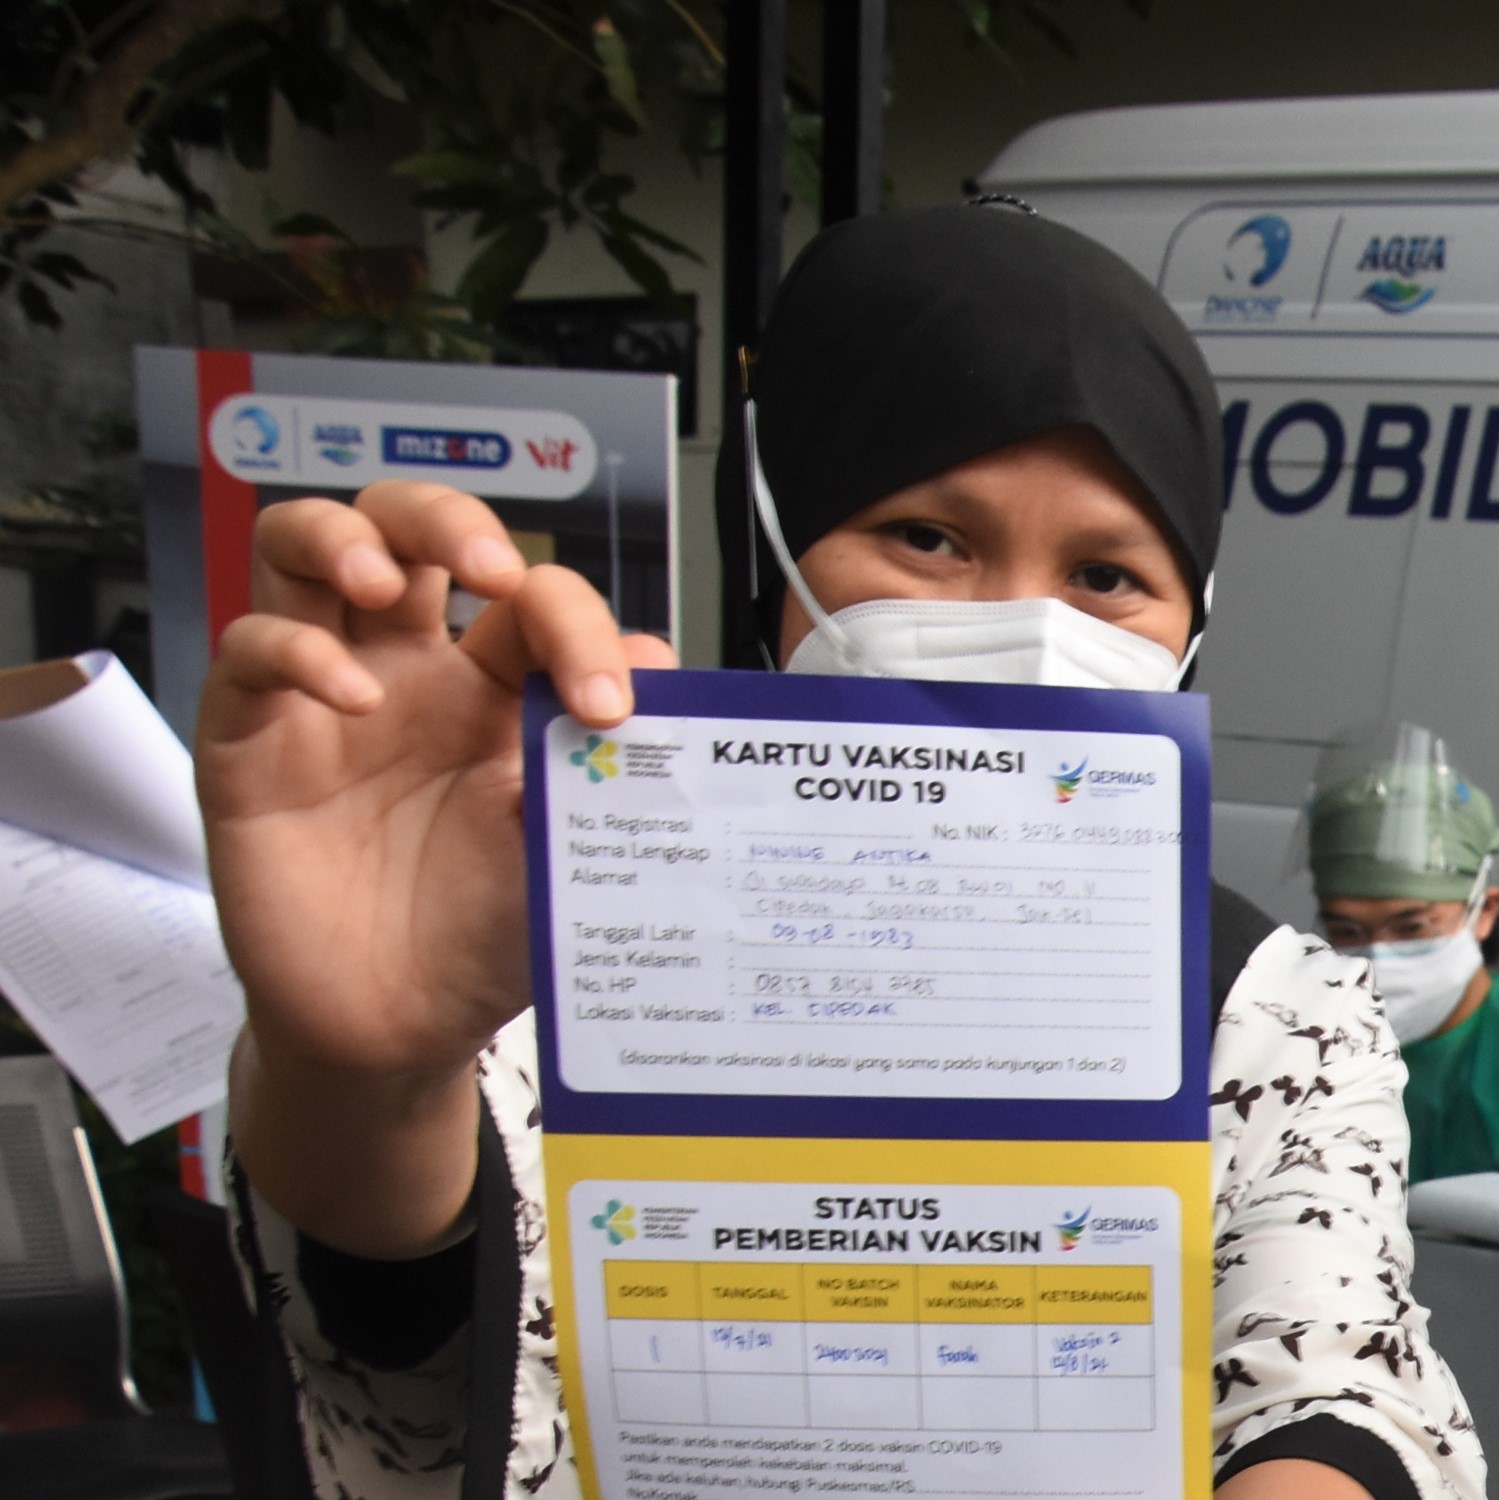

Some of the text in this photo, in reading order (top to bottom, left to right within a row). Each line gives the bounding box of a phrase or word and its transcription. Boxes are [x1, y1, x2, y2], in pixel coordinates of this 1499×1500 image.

[396, 433, 501, 463] mizone
[712, 739, 831, 769] KARTU
[842, 743, 1026, 774] VAKSINASI
[794, 777, 947, 804] COVID 19
[604, 814, 693, 835] Registrasi
[569, 841, 711, 864] Nama Lengkap
[569, 868, 638, 886] Alamat
[573, 922, 696, 944] Tanggal Lahir
[574, 951, 702, 968] Jenis Kelamin
[609, 976, 637, 993] HP
[575, 1003, 726, 1023] Lokasi Vaksinasi
[716, 1051, 786, 1068] vaksinasi
[788, 1050, 803, 1068] di
[807, 1051, 850, 1069] lokasi
[854, 1056, 893, 1073] yang
[896, 1058, 939, 1070] sama
[942, 1056, 982, 1073] pada
[986, 1056, 1062, 1075] kunjungan
[1078, 1056, 1106, 1072] dan
[814, 1196, 941, 1221] STATUS
[713, 1227, 1042, 1253] PEMBERIAN VAKSIN
[618, 1285, 790, 1301] DOSIS TANGGAL
[816, 1278, 900, 1291] NO BATCH
[949, 1279, 999, 1291] NAMA
[831, 1295, 889, 1308] VAKSIN
[926, 1296, 1025, 1309] VAKSINATOR
[1040, 1290, 1148, 1302] KETERANGAN
[823, 1439, 833, 1453] 2
